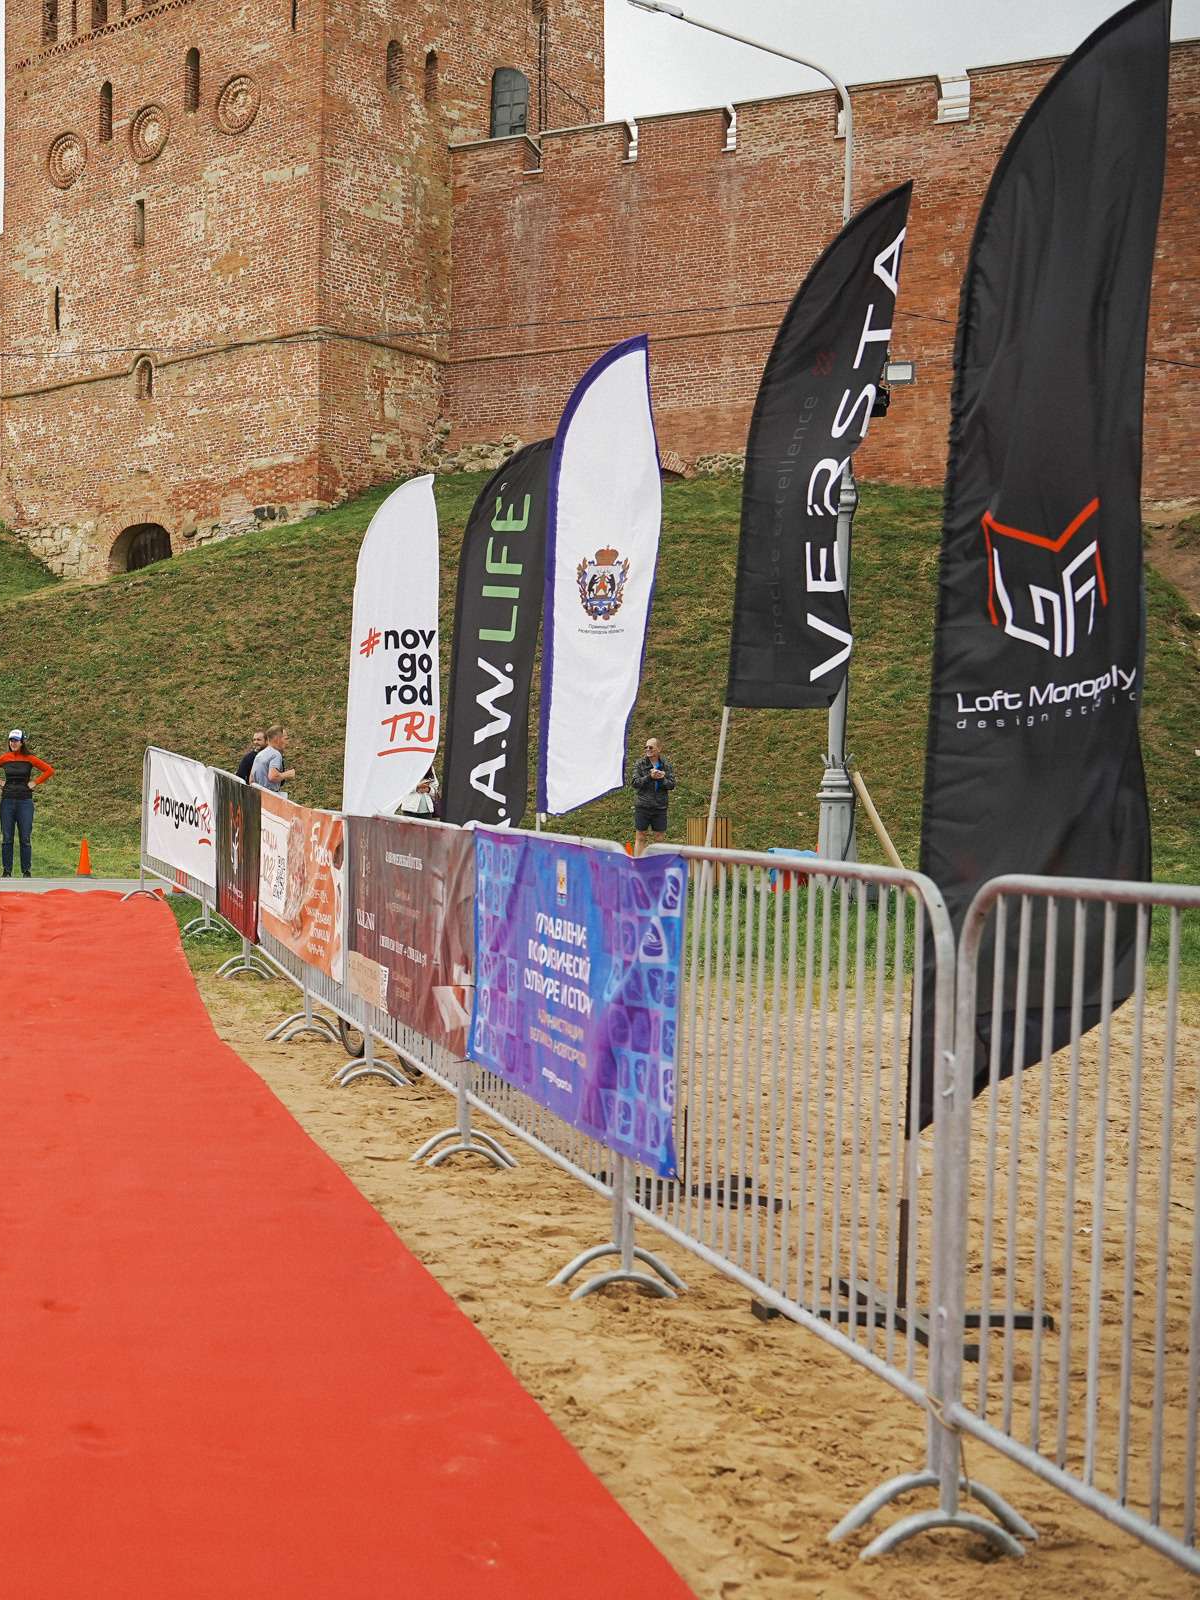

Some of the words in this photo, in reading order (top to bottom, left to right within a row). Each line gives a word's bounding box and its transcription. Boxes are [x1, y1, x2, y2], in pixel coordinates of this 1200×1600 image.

[773, 395, 818, 537] excellence
[806, 226, 907, 682] VERSTA
[359, 627, 436, 658] #nov
[398, 652, 433, 682] go
[385, 674, 433, 706] rod
[956, 690, 1023, 713] Loft
[381, 711, 436, 743] TRI
[956, 712, 1049, 729] design
